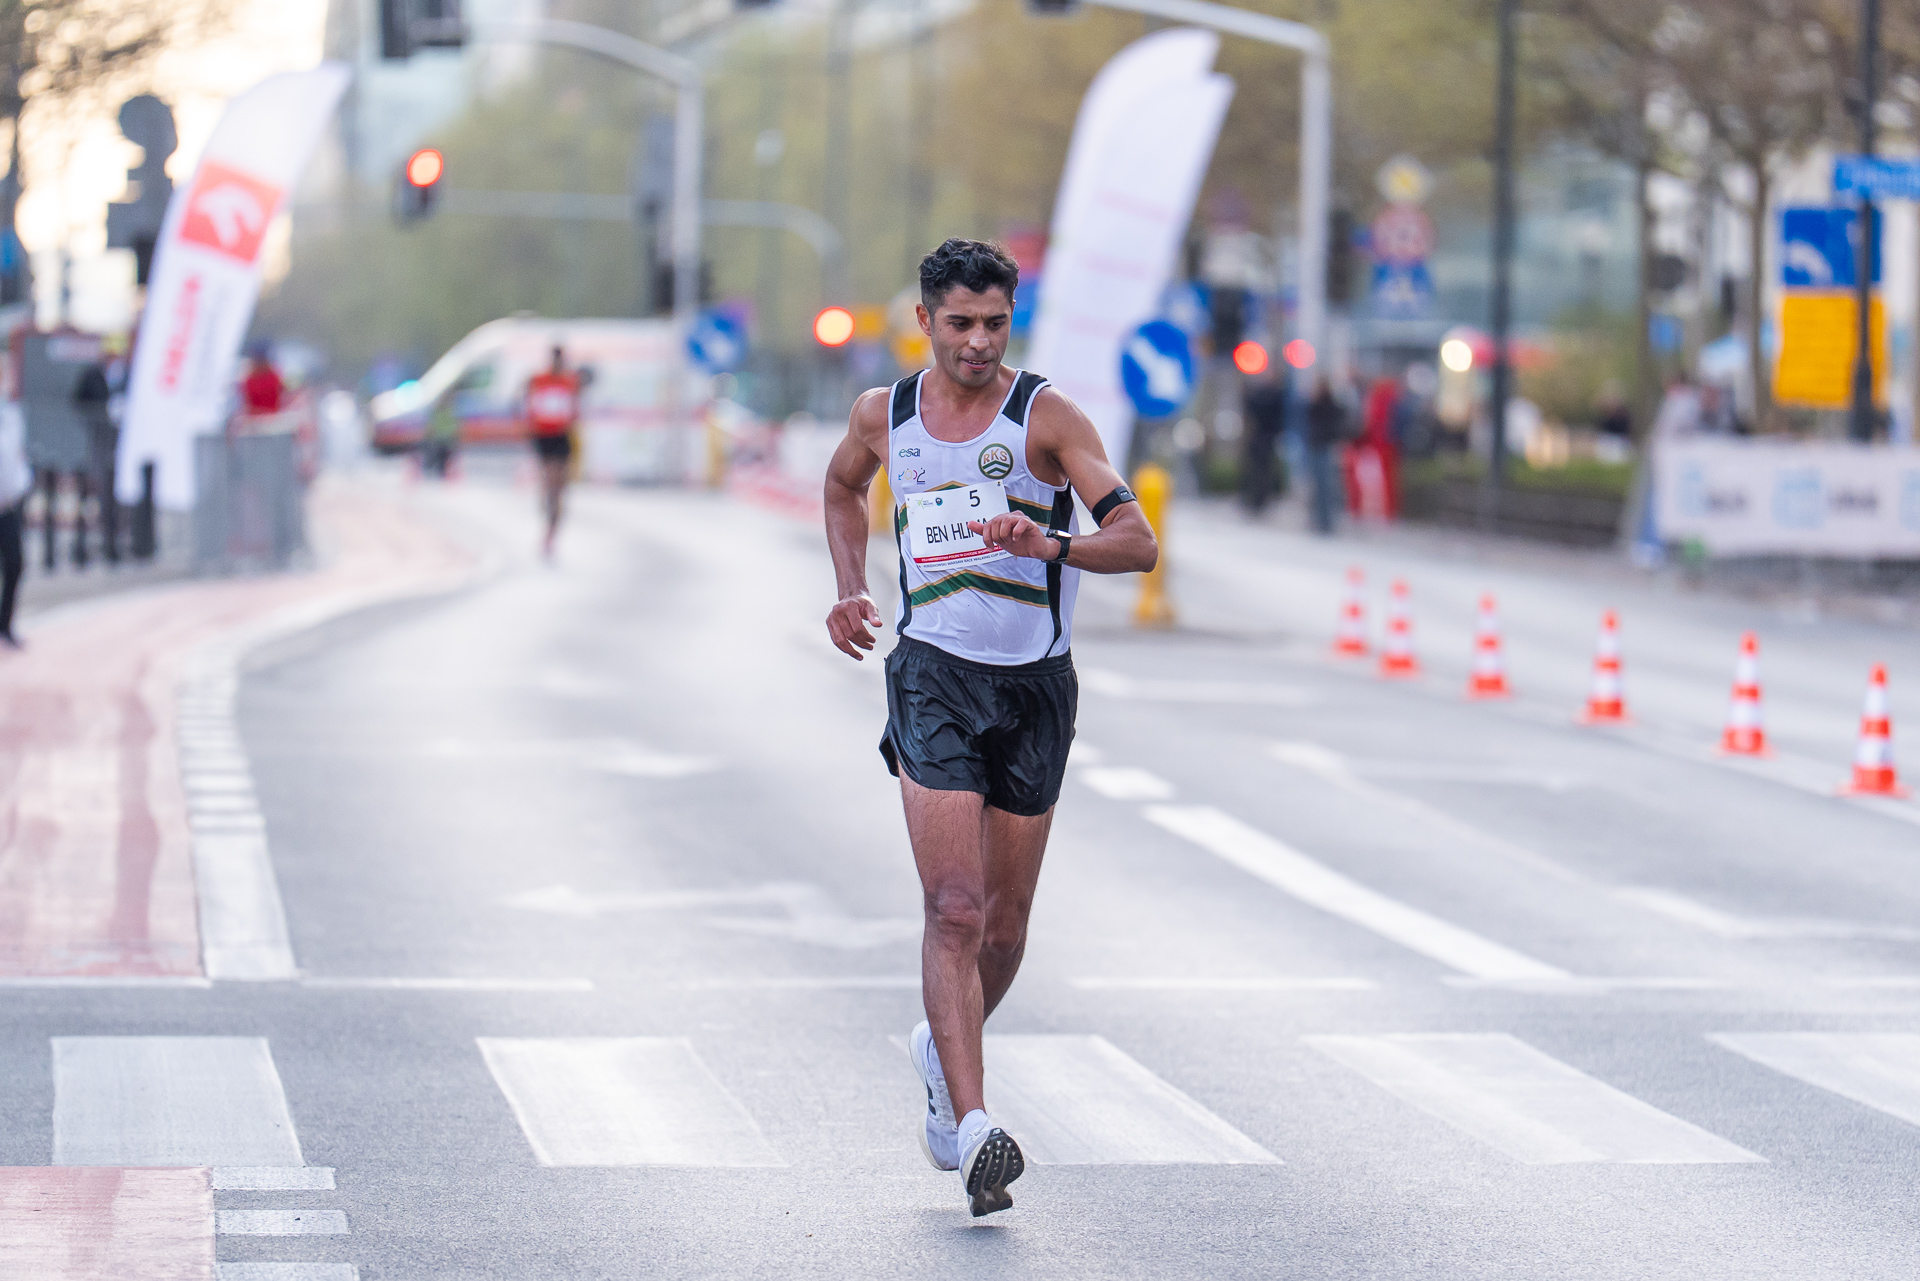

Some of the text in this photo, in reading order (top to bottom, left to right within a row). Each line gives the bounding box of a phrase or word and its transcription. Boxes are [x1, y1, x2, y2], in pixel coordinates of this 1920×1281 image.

[983, 448, 1007, 464] RKS
[969, 489, 980, 507] 5
[926, 518, 988, 543] BEN HLI
